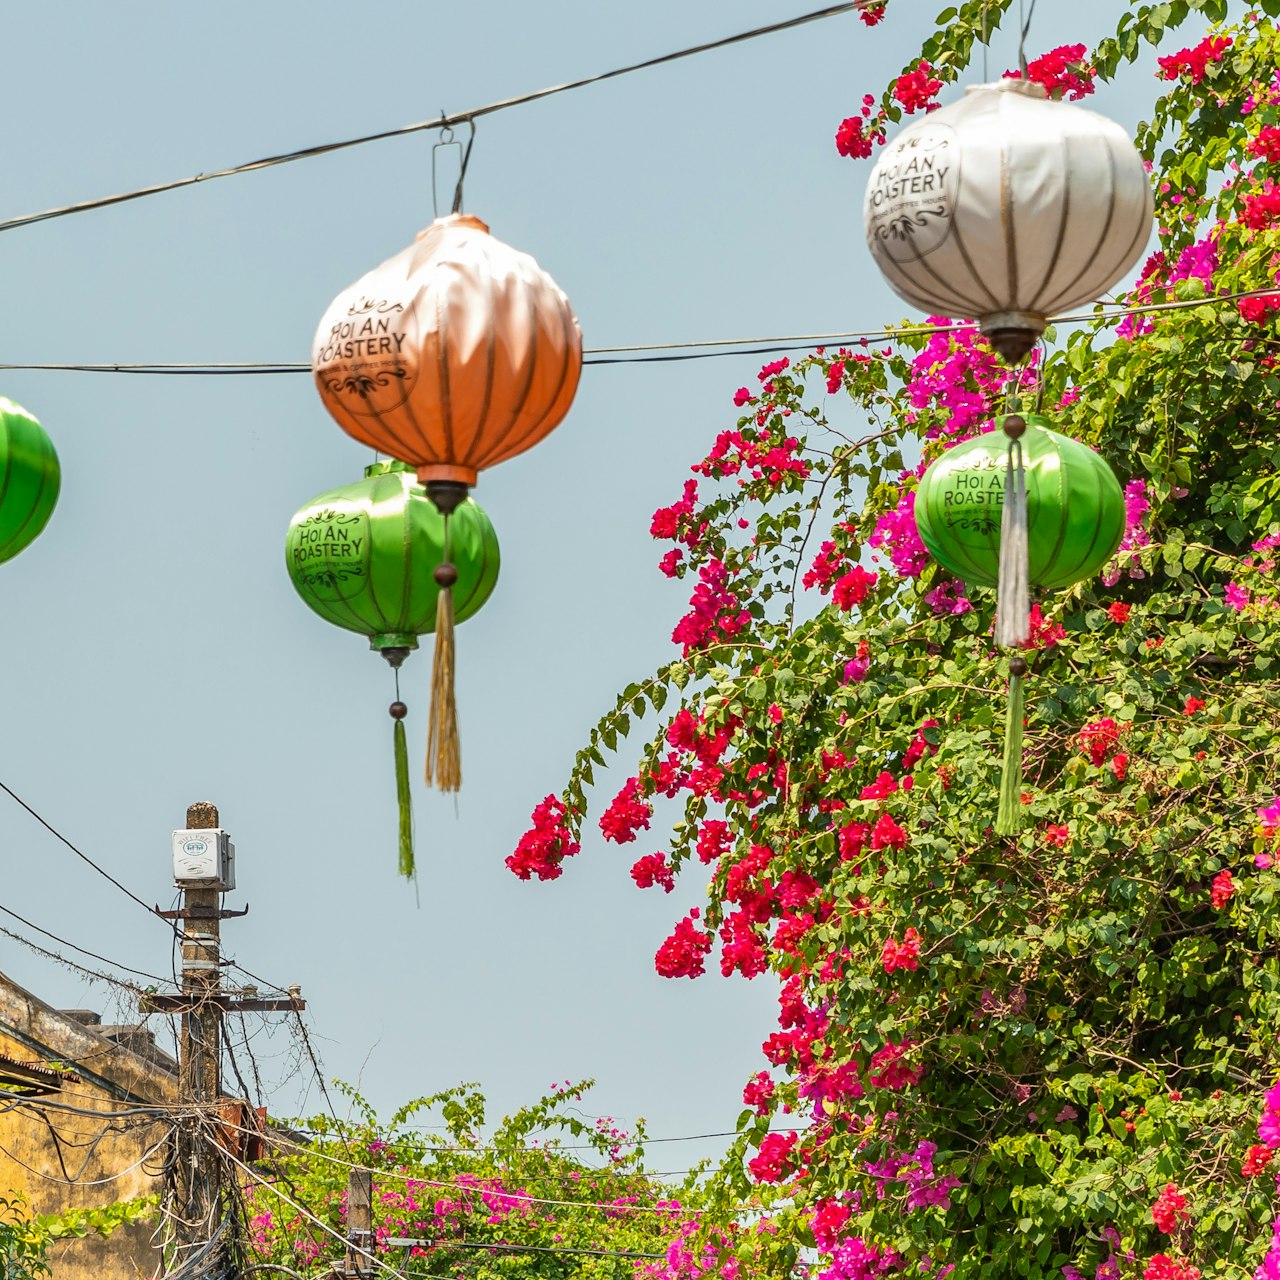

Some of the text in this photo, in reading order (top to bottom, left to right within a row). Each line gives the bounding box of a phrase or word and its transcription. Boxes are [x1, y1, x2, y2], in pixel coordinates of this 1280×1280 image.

[905, 155, 935, 175] AN
[329, 317, 390, 345] HOI AN
[956, 474, 984, 490] HOI
[300, 525, 349, 546] HOI AN
[293, 537, 363, 565] ROASTERY
